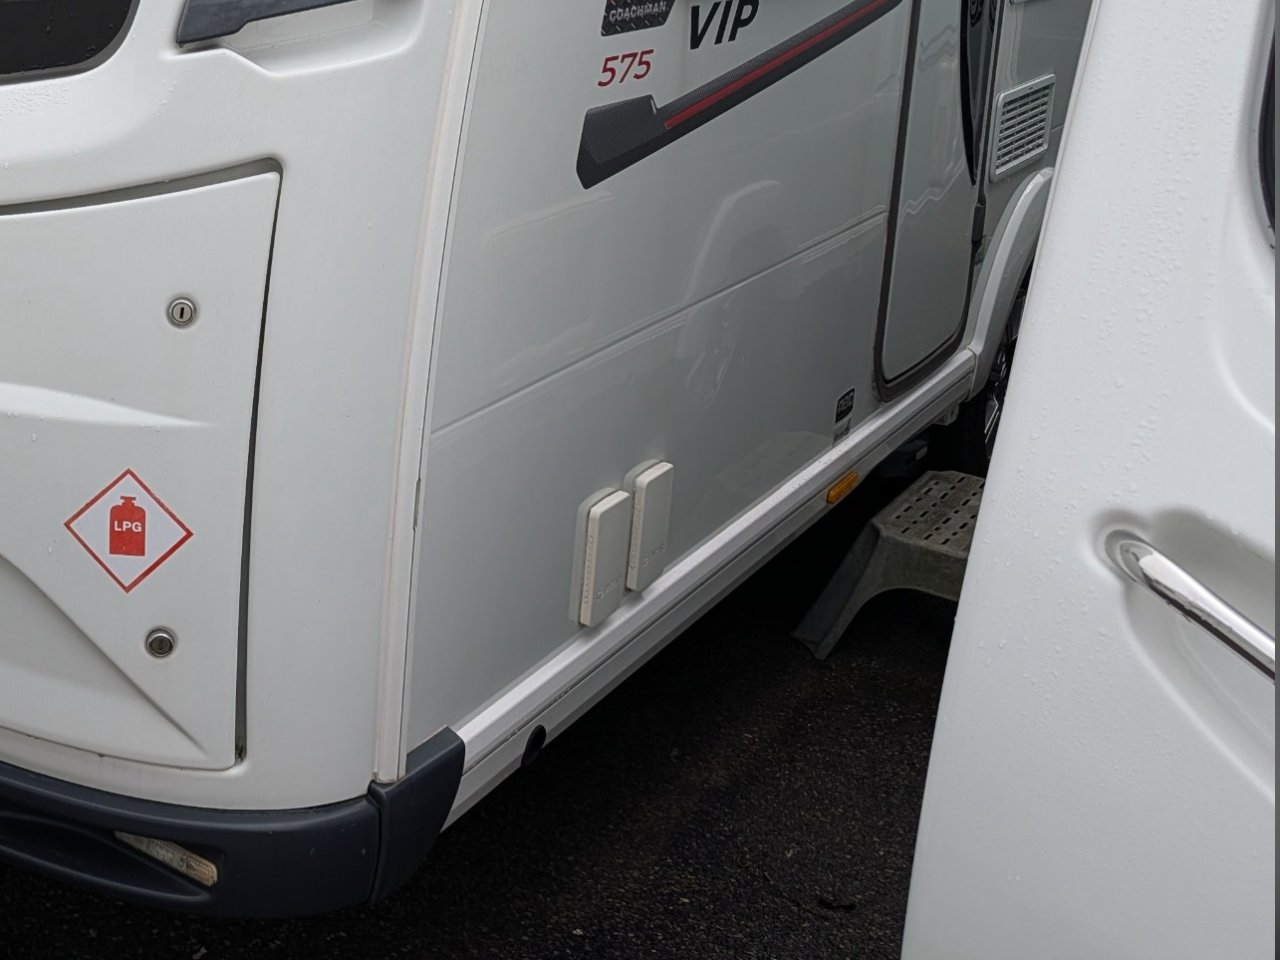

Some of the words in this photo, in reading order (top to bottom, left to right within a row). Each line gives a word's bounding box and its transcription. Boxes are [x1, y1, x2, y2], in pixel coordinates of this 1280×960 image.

[609, 0, 669, 24] COACHMAN
[597, 49, 655, 87] 575
[114, 520, 143, 533] LPG
